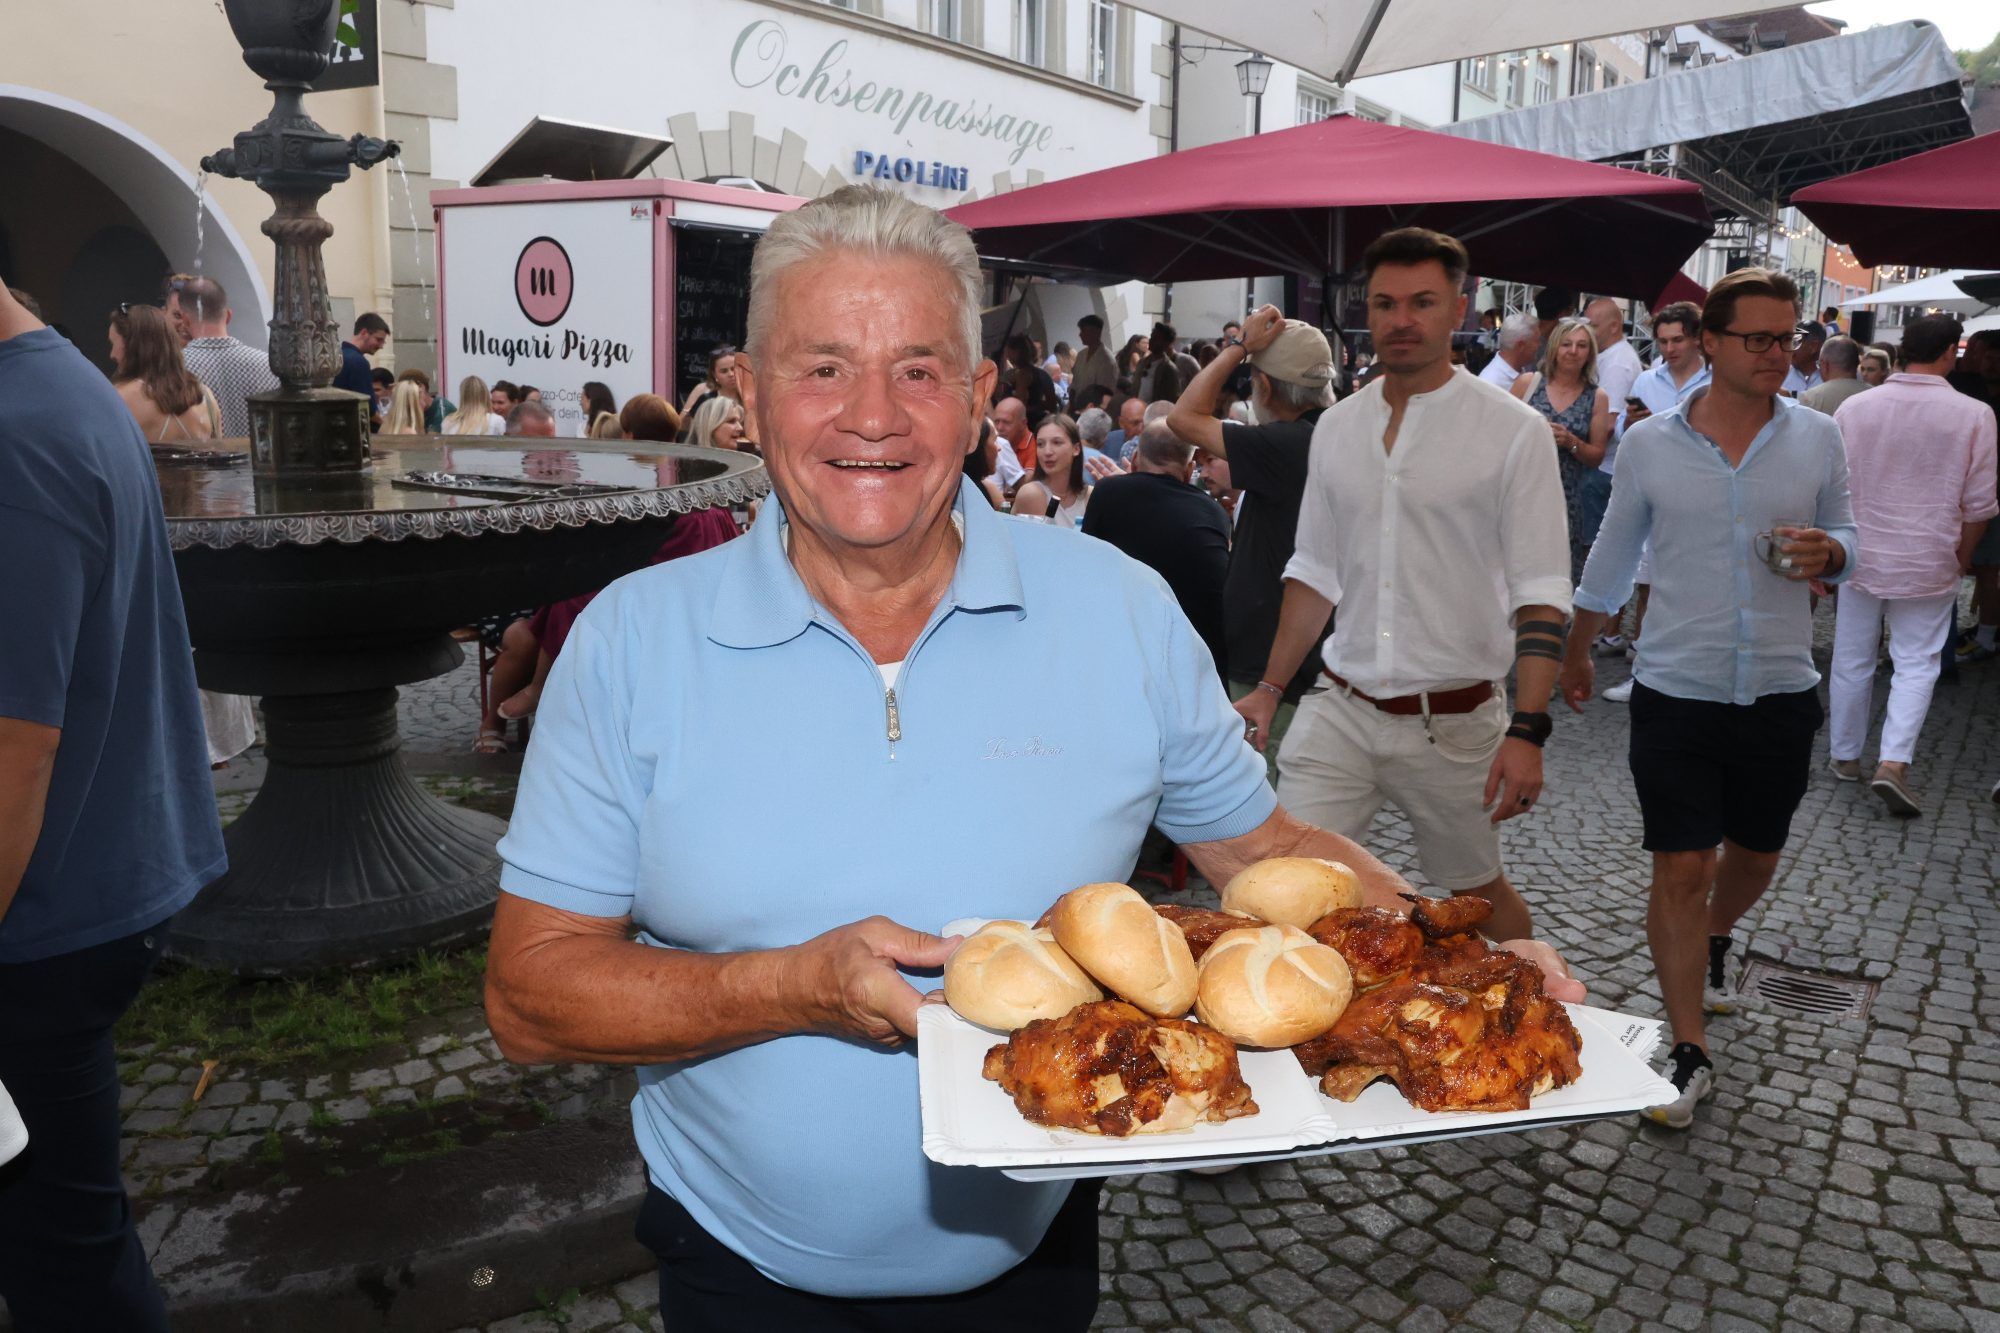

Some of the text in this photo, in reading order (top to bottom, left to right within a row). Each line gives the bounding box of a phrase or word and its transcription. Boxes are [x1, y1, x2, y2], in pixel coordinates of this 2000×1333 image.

[730, 19, 1054, 165] Ochsenpassage
[462, 326, 634, 368] Magari Pizza
